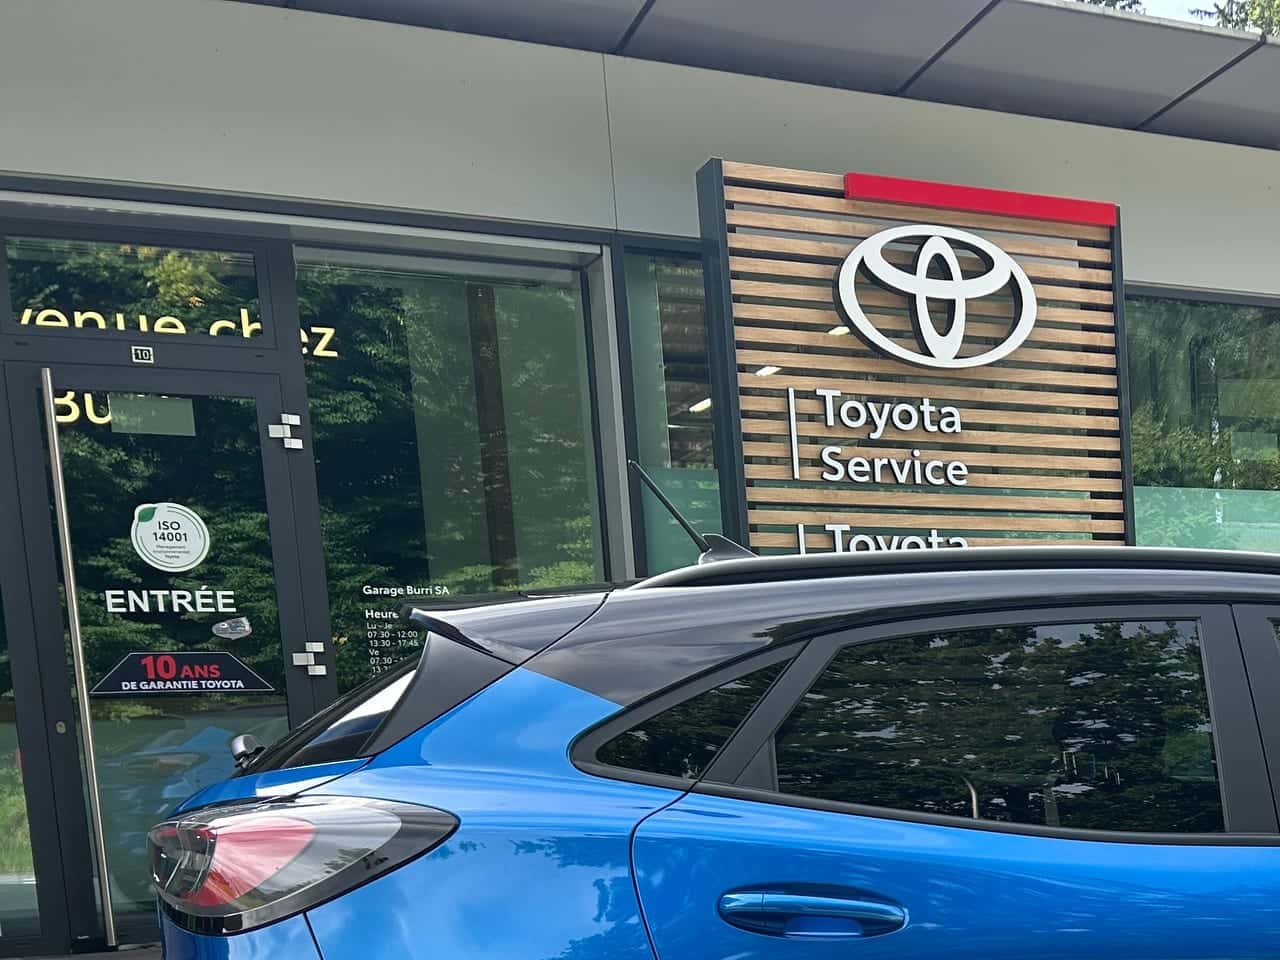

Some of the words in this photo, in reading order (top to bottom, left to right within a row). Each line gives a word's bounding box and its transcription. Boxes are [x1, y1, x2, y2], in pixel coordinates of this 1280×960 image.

[135, 348, 150, 361] 10
[815, 388, 962, 439] Toyota
[821, 446, 969, 486] Service
[158, 520, 181, 531] ISO
[153, 532, 188, 542] 14001
[362, 585, 405, 597] Garage
[406, 585, 433, 595] Burri
[434, 586, 450, 595] SA
[105, 585, 237, 613] ENTRÉE
[140, 655, 177, 680] 10
[180, 664, 221, 679] ANS
[121, 681, 137, 691] DE
[139, 680, 200, 691] GARANTIE
[200, 679, 245, 690] TOYOTA
